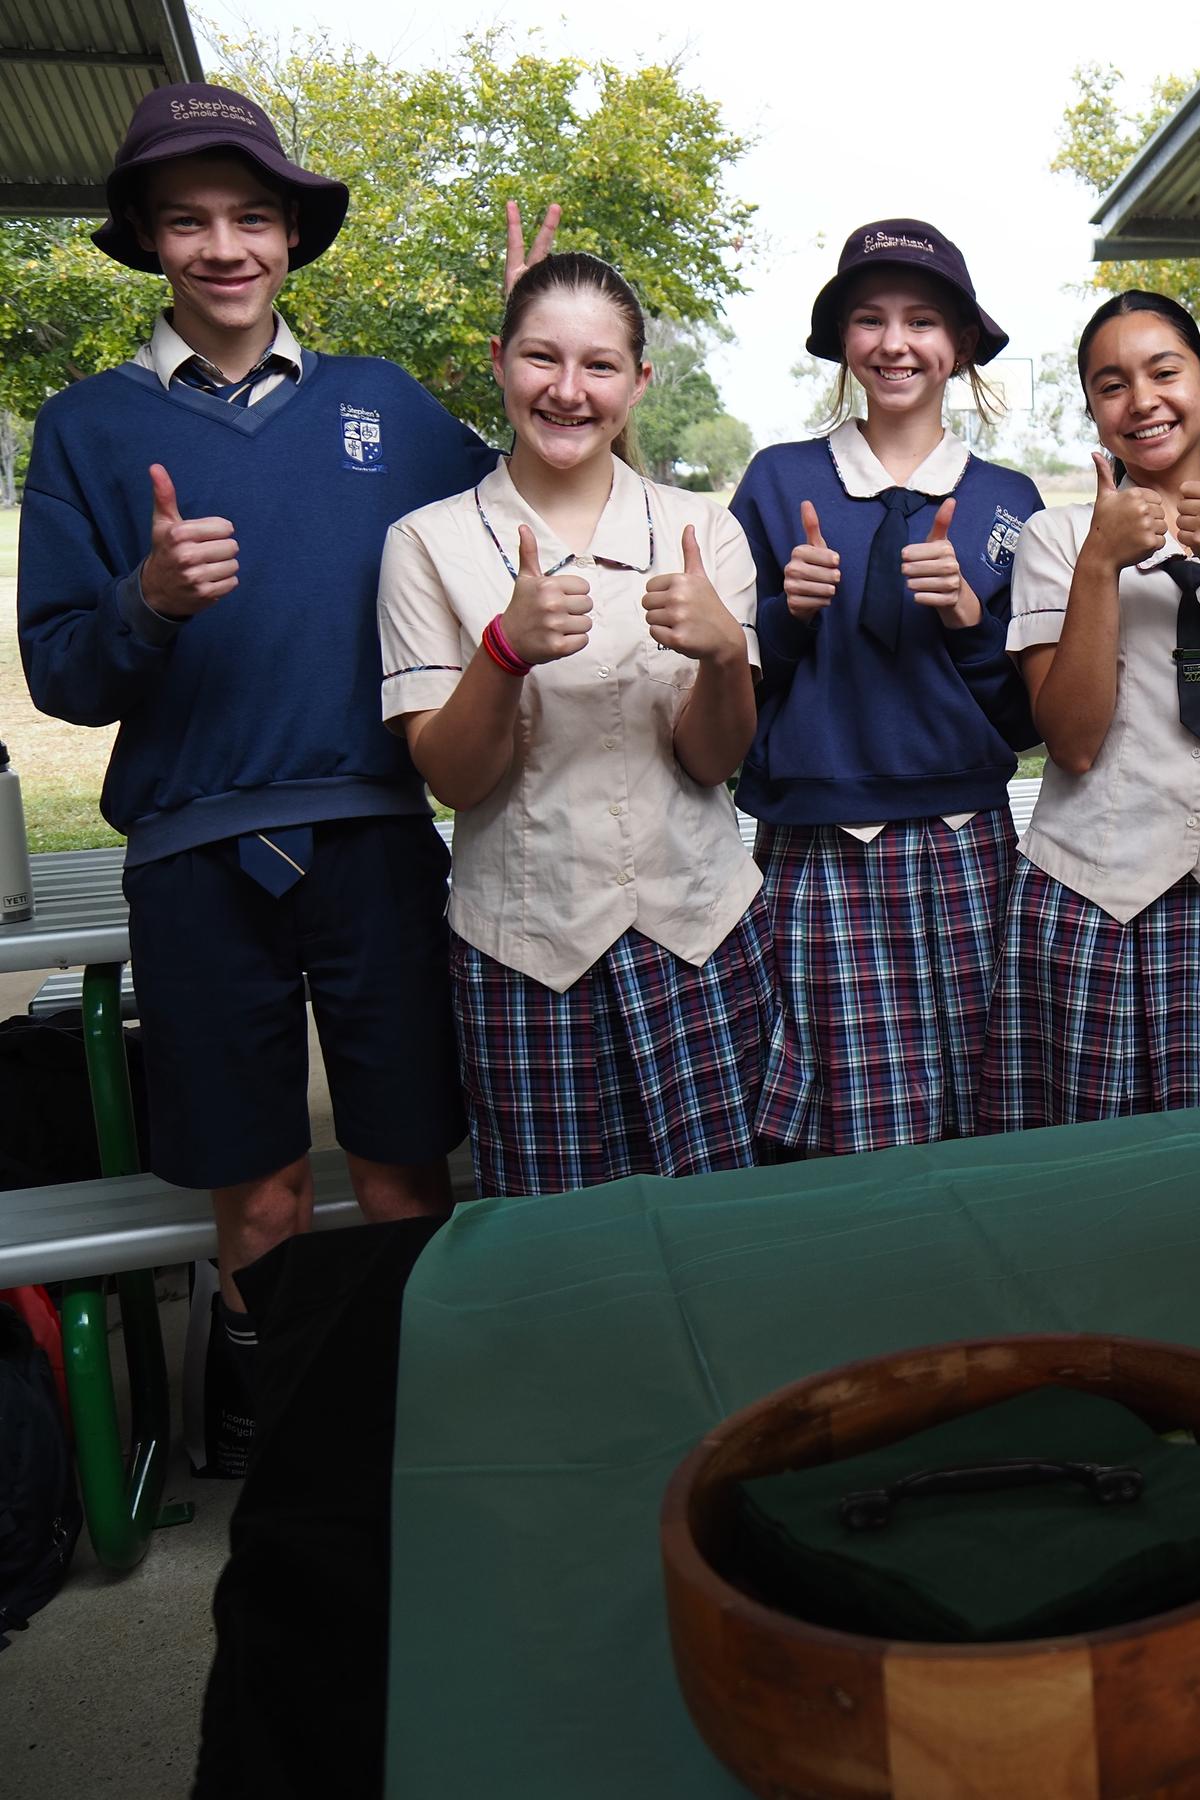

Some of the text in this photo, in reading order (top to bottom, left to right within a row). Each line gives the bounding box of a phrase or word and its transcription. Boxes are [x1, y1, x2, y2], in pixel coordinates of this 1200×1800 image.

[170, 100, 186, 113] St
[173, 109, 219, 120] Catholic
[5, 895, 27, 905] YETI
